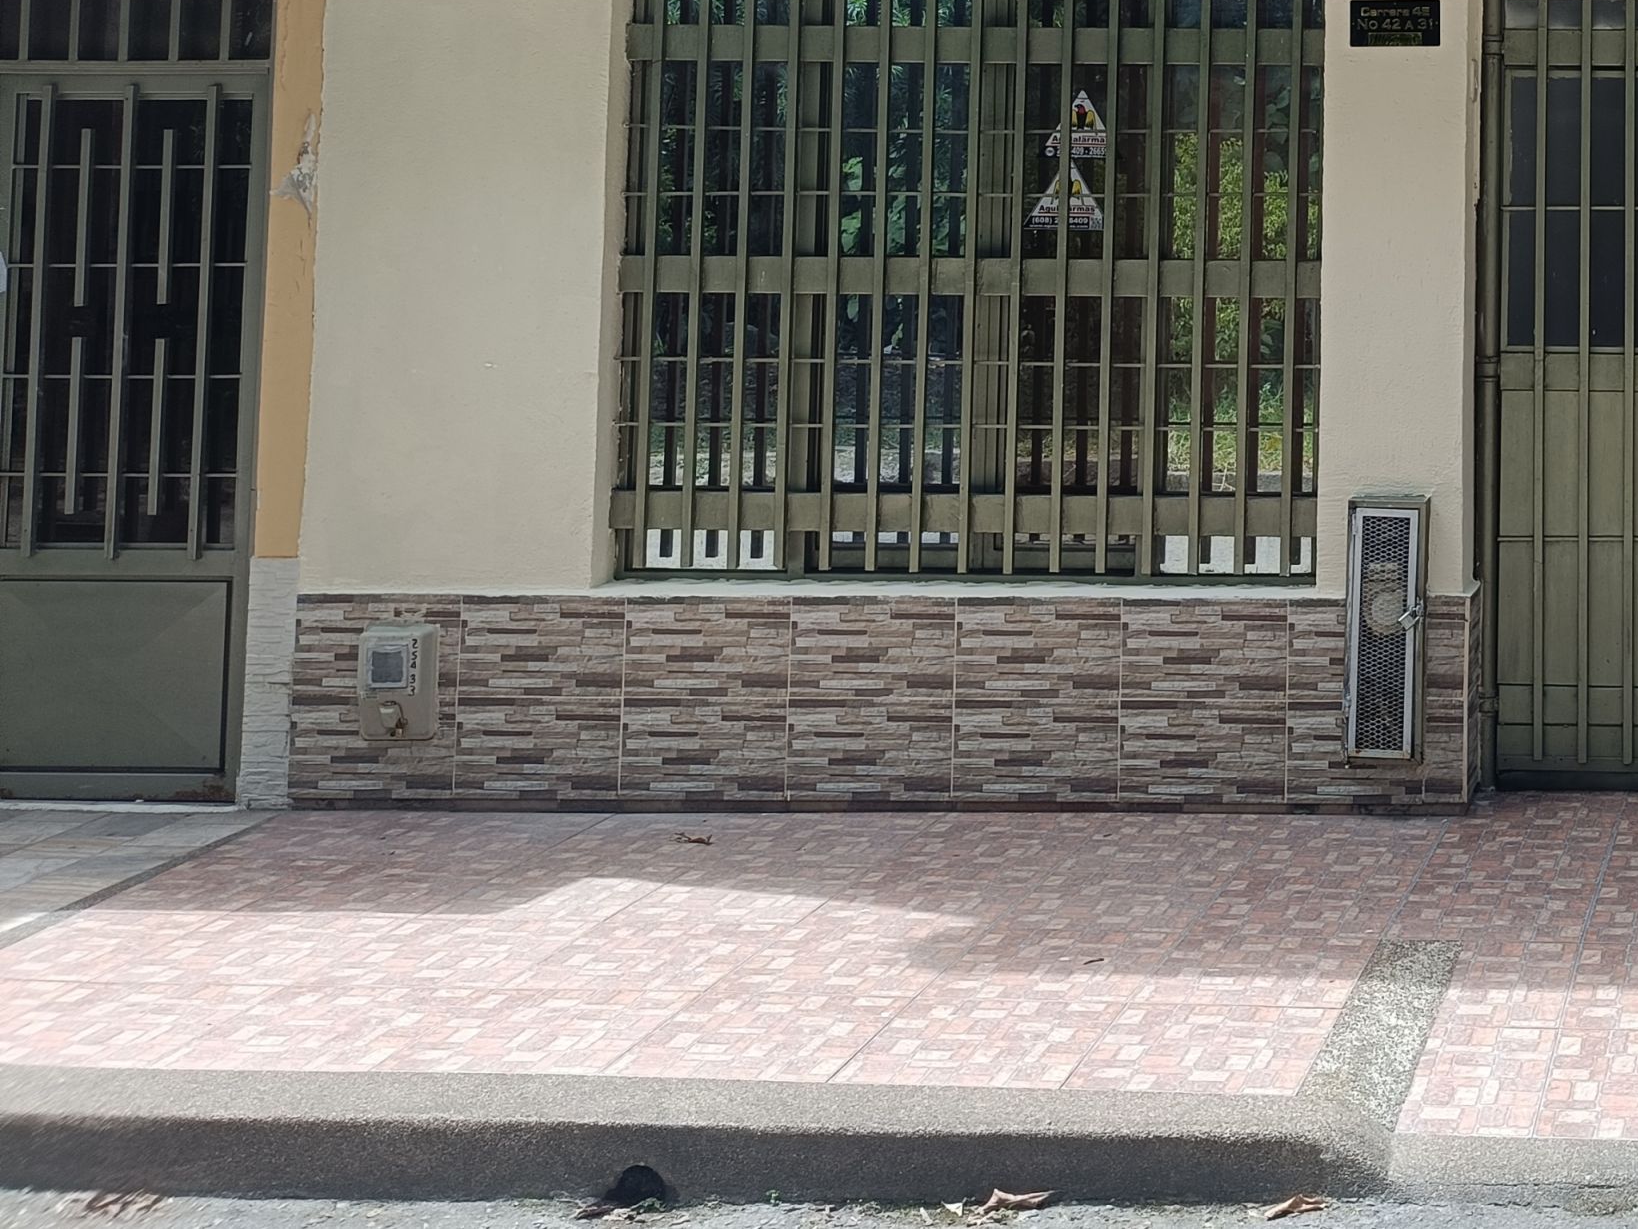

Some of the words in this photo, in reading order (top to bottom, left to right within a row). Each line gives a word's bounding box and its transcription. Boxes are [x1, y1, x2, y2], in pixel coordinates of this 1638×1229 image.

[1360, 7, 1410, 17] Carrera
[1382, 18, 1401, 30] 42
[1404, 19, 1414, 30] A
